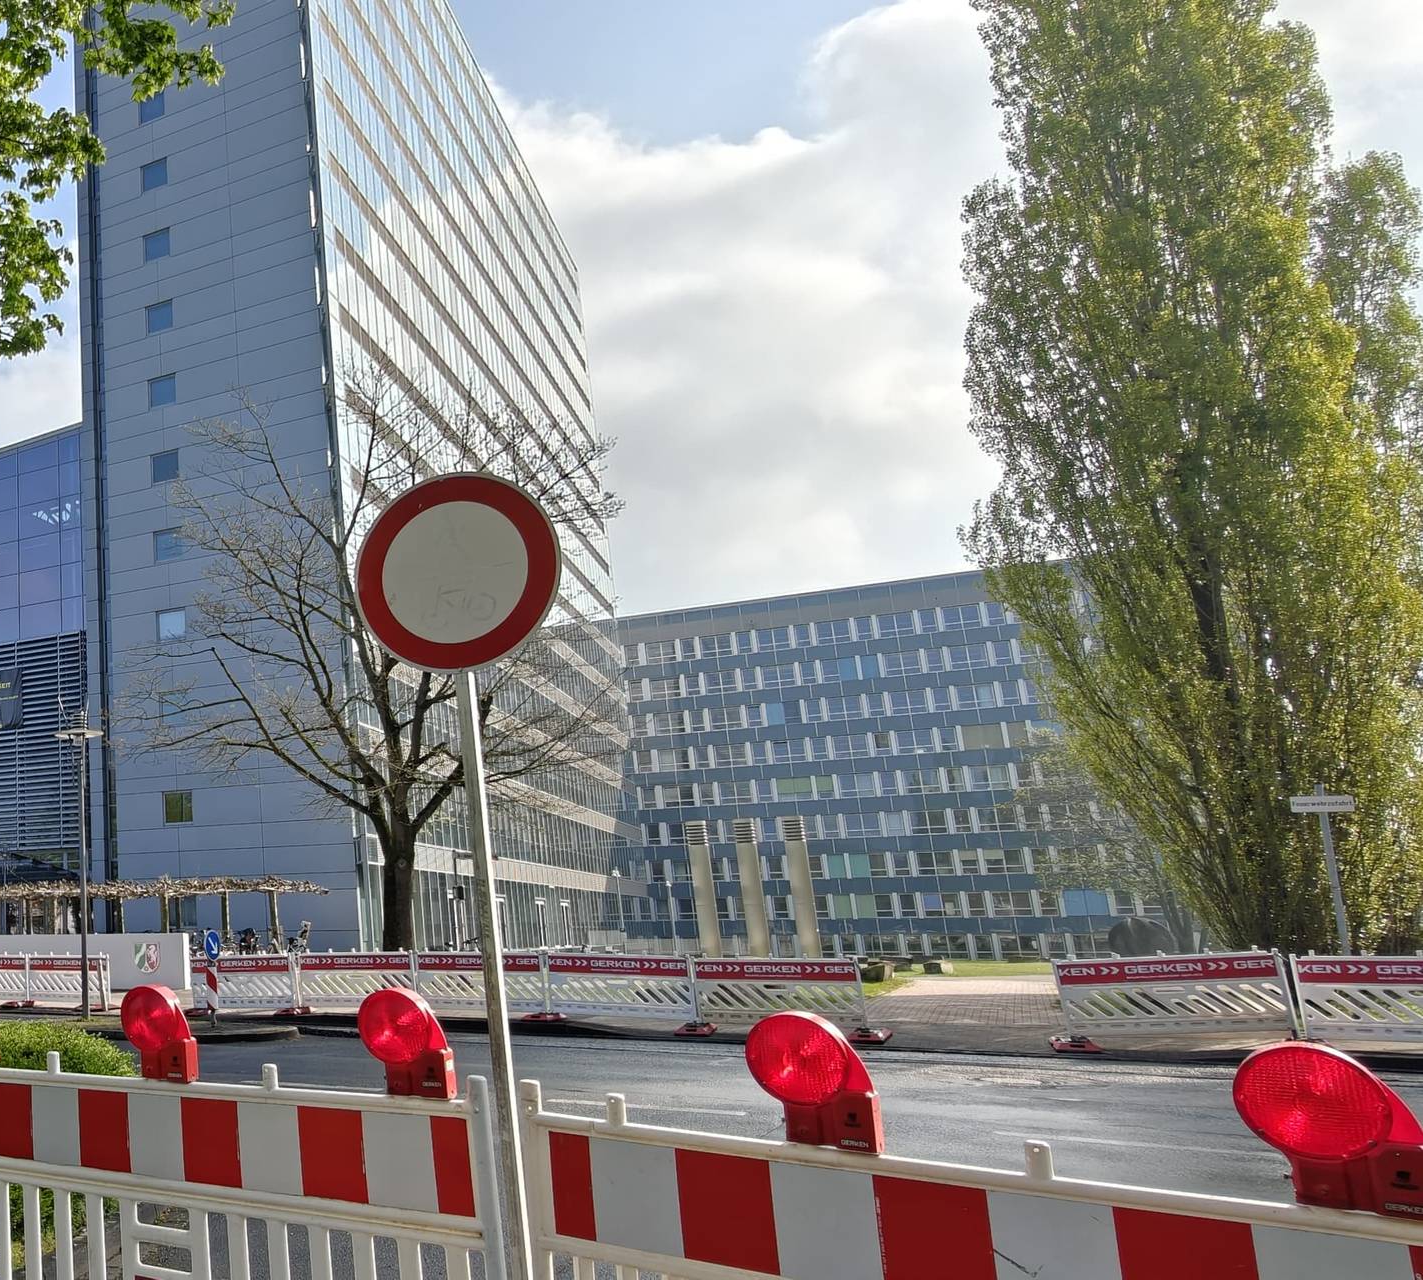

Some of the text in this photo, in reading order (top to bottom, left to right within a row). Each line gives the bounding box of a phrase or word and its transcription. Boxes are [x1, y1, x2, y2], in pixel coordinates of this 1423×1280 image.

[334, 957, 374, 965] GERKEN
[419, 957, 440, 965] KEN
[455, 957, 483, 965] GERK
[549, 958, 687, 970] KEN GERKEN GER
[696, 964, 855, 974] KEN GERKEN GER
[1058, 959, 1275, 977] KEN GERKEN GER
[1297, 964, 1342, 974] KEN
